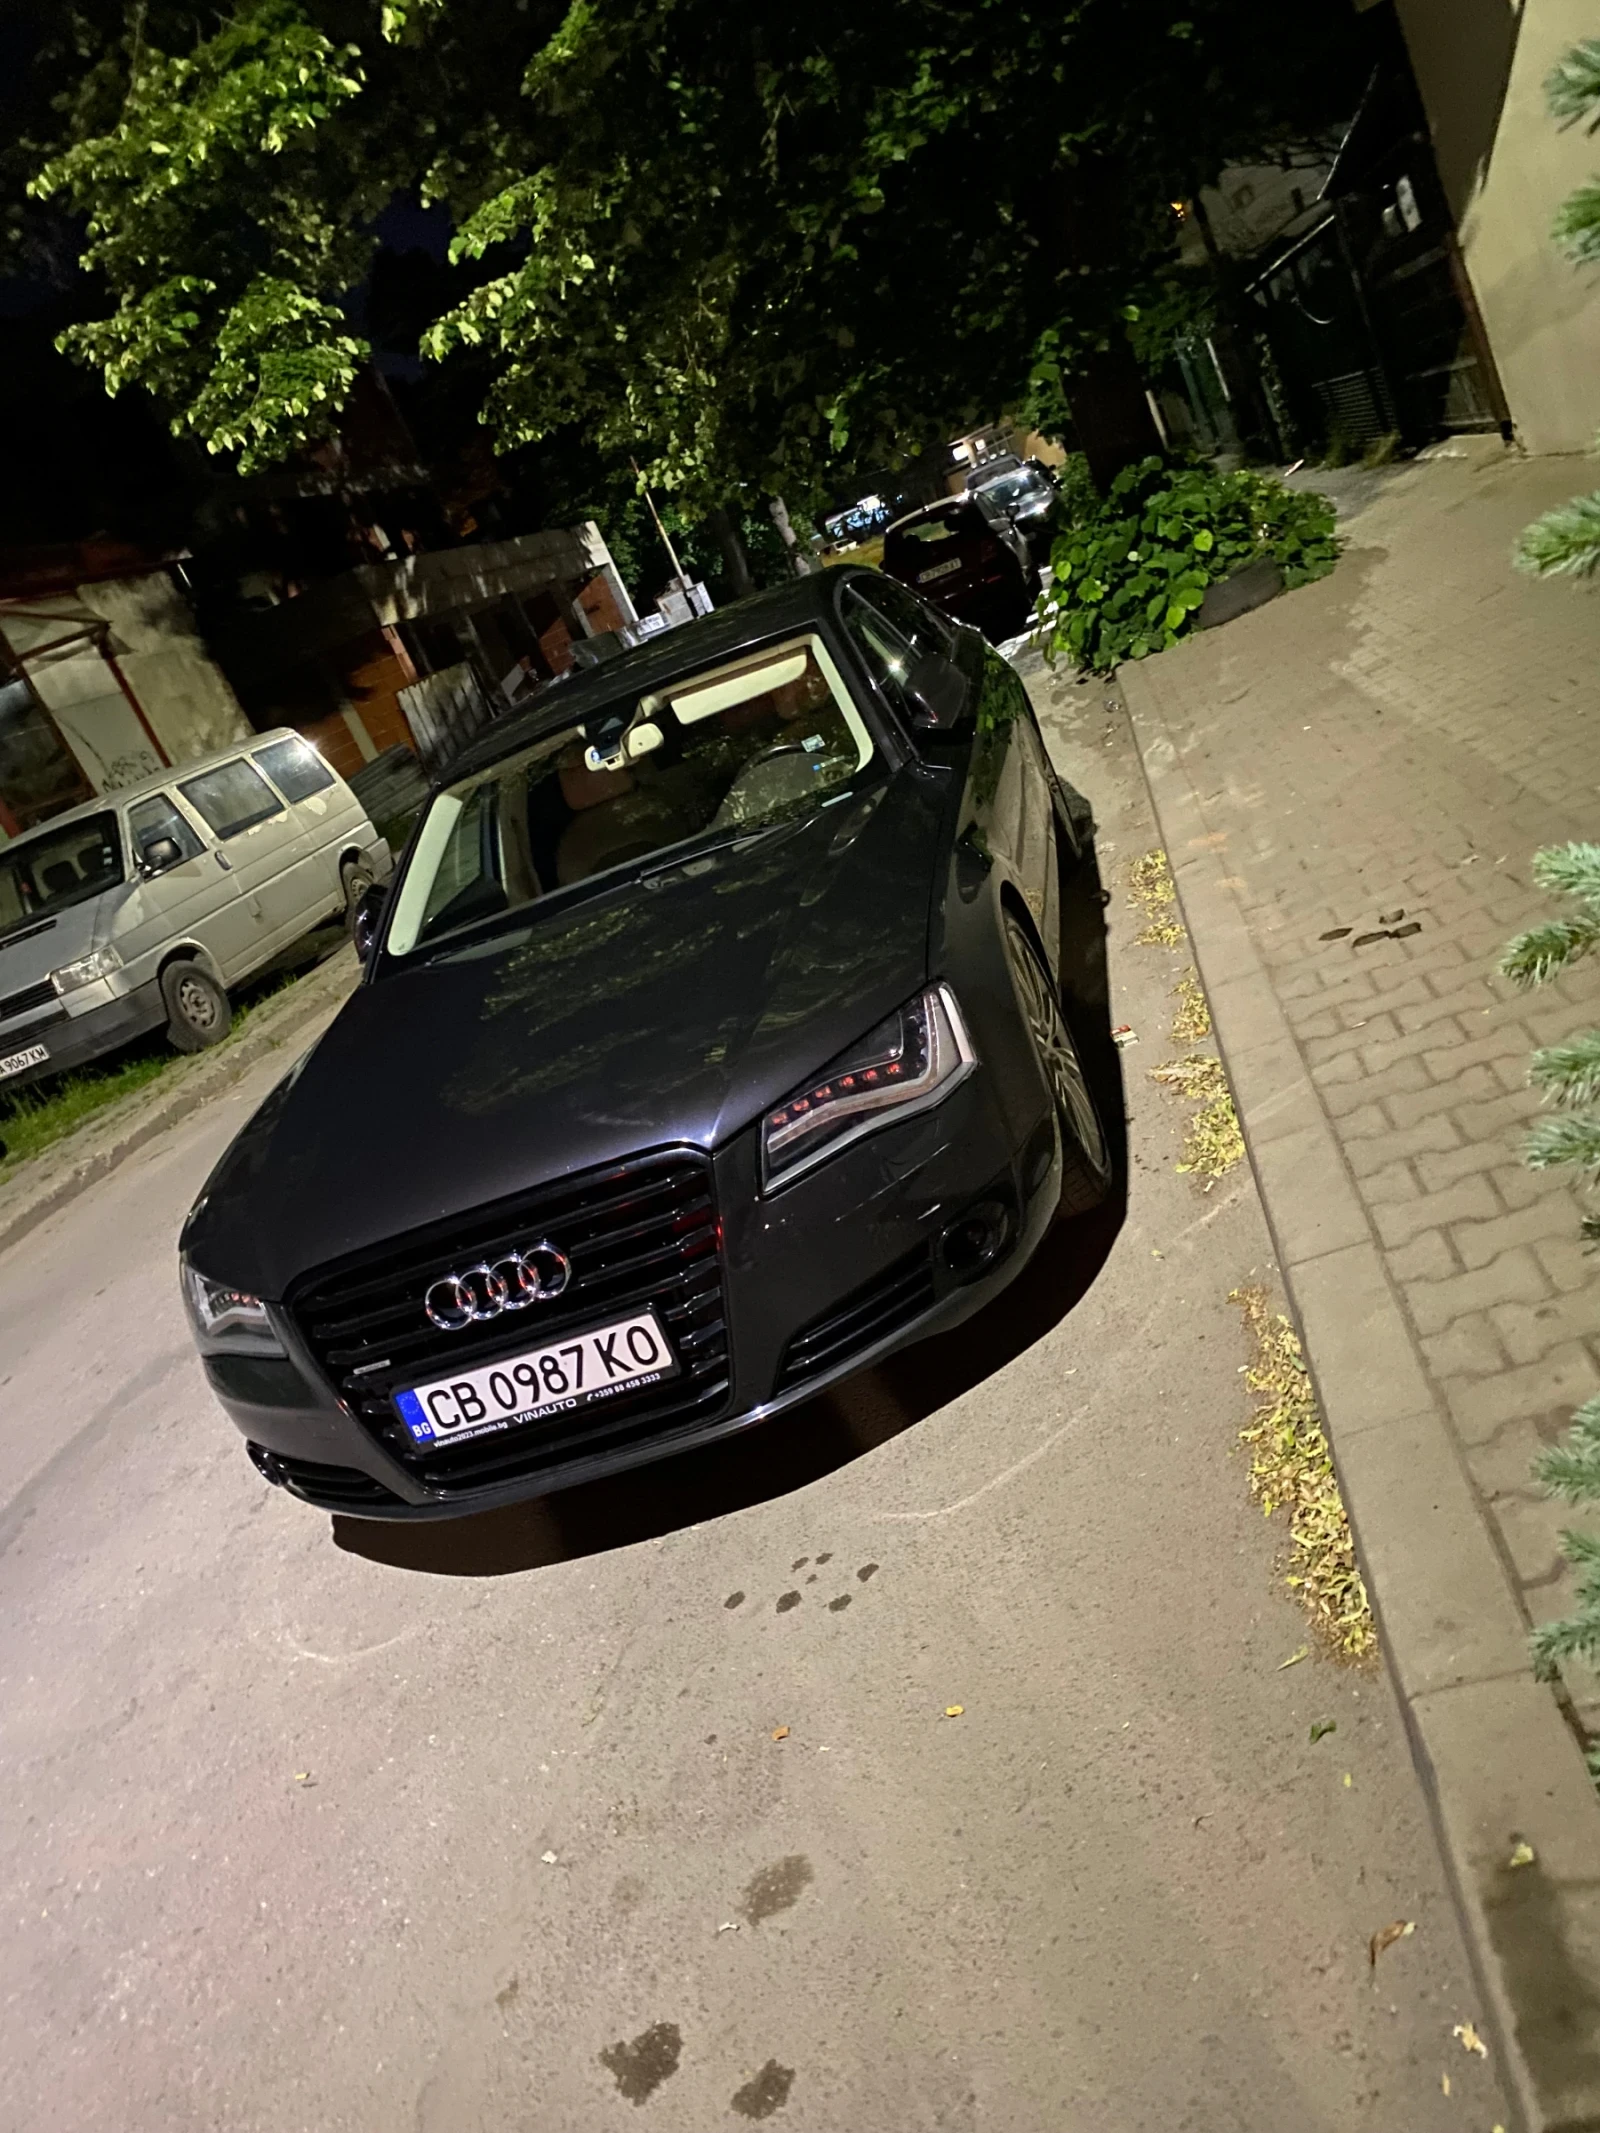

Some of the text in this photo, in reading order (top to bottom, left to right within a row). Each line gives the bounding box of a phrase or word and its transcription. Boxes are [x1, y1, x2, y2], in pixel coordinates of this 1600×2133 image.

[4, 1053, 29, 1071] 9067
[29, 1047, 46, 1062] KM
[427, 1325, 659, 1429] CB 0987 KO
[594, 1387, 613, 1398] +359
[640, 1372, 660, 1384] 3333
[513, 1397, 577, 1425] VINAUTO
[412, 1422, 432, 1438] BG
